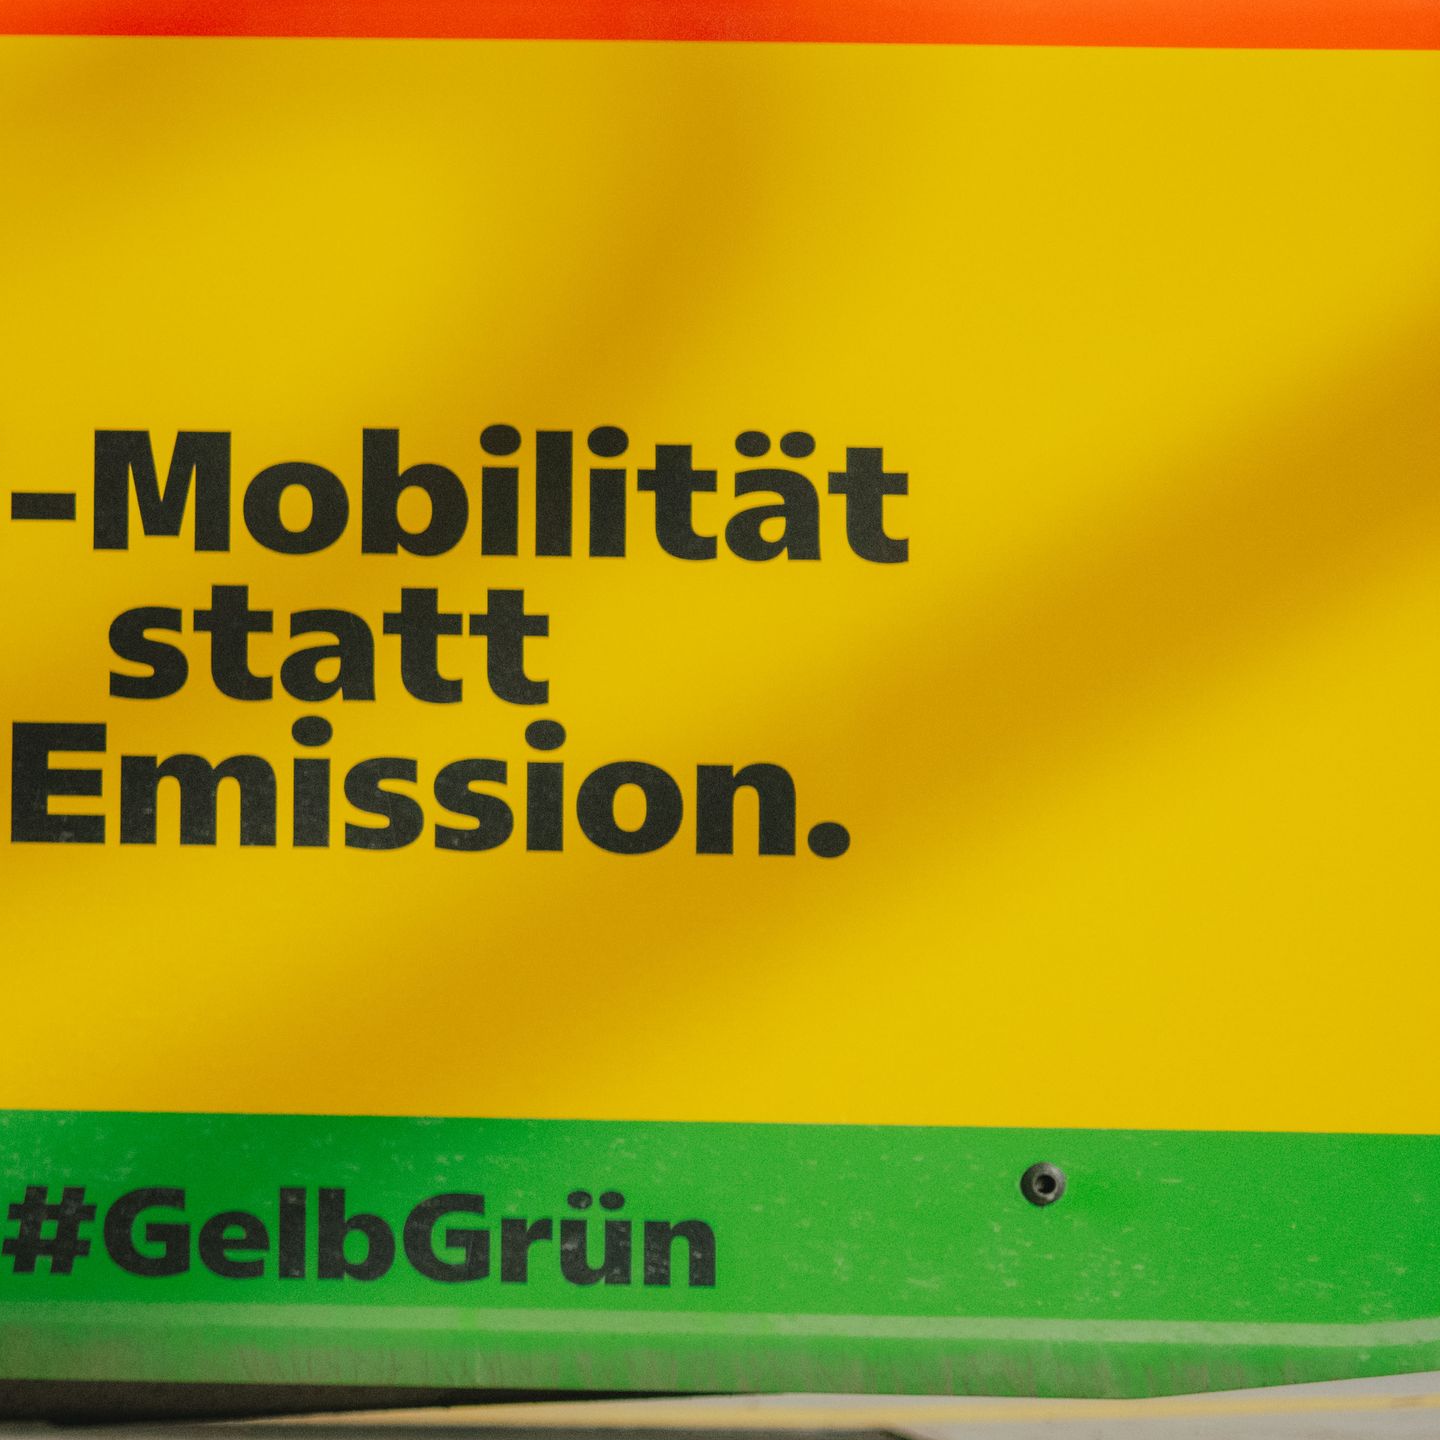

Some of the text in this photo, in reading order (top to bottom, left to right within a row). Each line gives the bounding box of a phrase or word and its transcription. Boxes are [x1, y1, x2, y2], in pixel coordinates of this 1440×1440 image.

[108, 583, 550, 707] statt
[10, 715, 852, 859] Emission.
[0, 1184, 717, 1288] #GelbGrün
